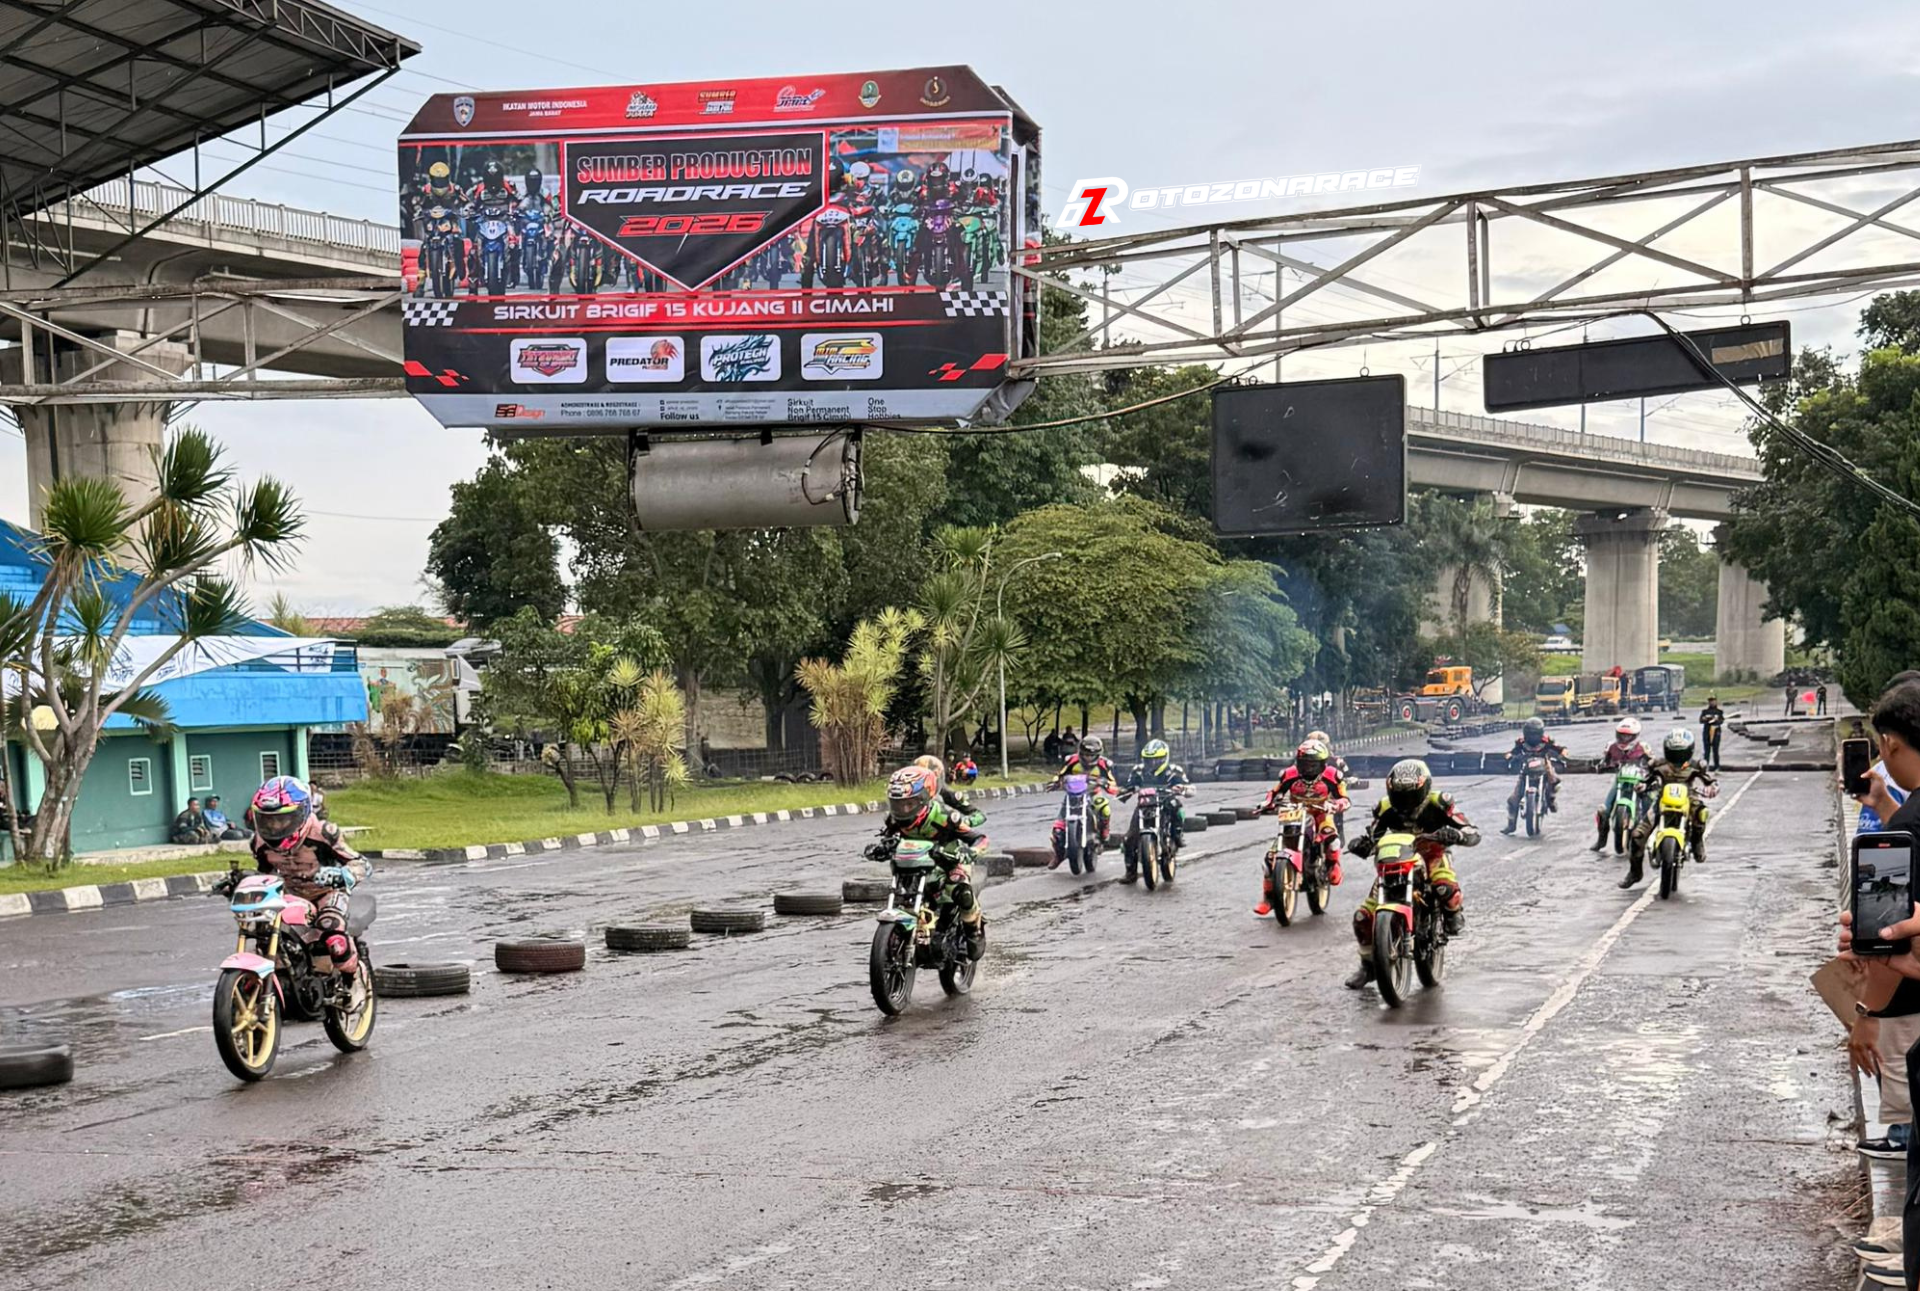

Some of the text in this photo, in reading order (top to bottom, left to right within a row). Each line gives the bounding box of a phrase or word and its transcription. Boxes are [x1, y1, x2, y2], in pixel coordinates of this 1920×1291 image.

[503, 100, 588, 111] IKATAN MOTOR INDONESIA
[577, 148, 812, 184] SUMBER PRODUCTION
[577, 181, 812, 205] ROADRACE
[617, 211, 773, 237] 2026
[494, 304, 580, 320] SIRKUIT
[586, 303, 658, 319] BRIGIF
[664, 303, 686, 318] 15
[693, 301, 785, 317] KUJANG
[809, 298, 894, 314] CIMAHI
[609, 357, 669, 366] PREDATOR
[712, 348, 768, 366] PROTECH
[787, 398, 814, 406] Sirkuit
[867, 397, 884, 406] One
[560, 409, 582, 417] Phone
[787, 405, 850, 415] Non Permanent
[867, 405, 887, 414] Stop
[660, 411, 687, 421] Follow
